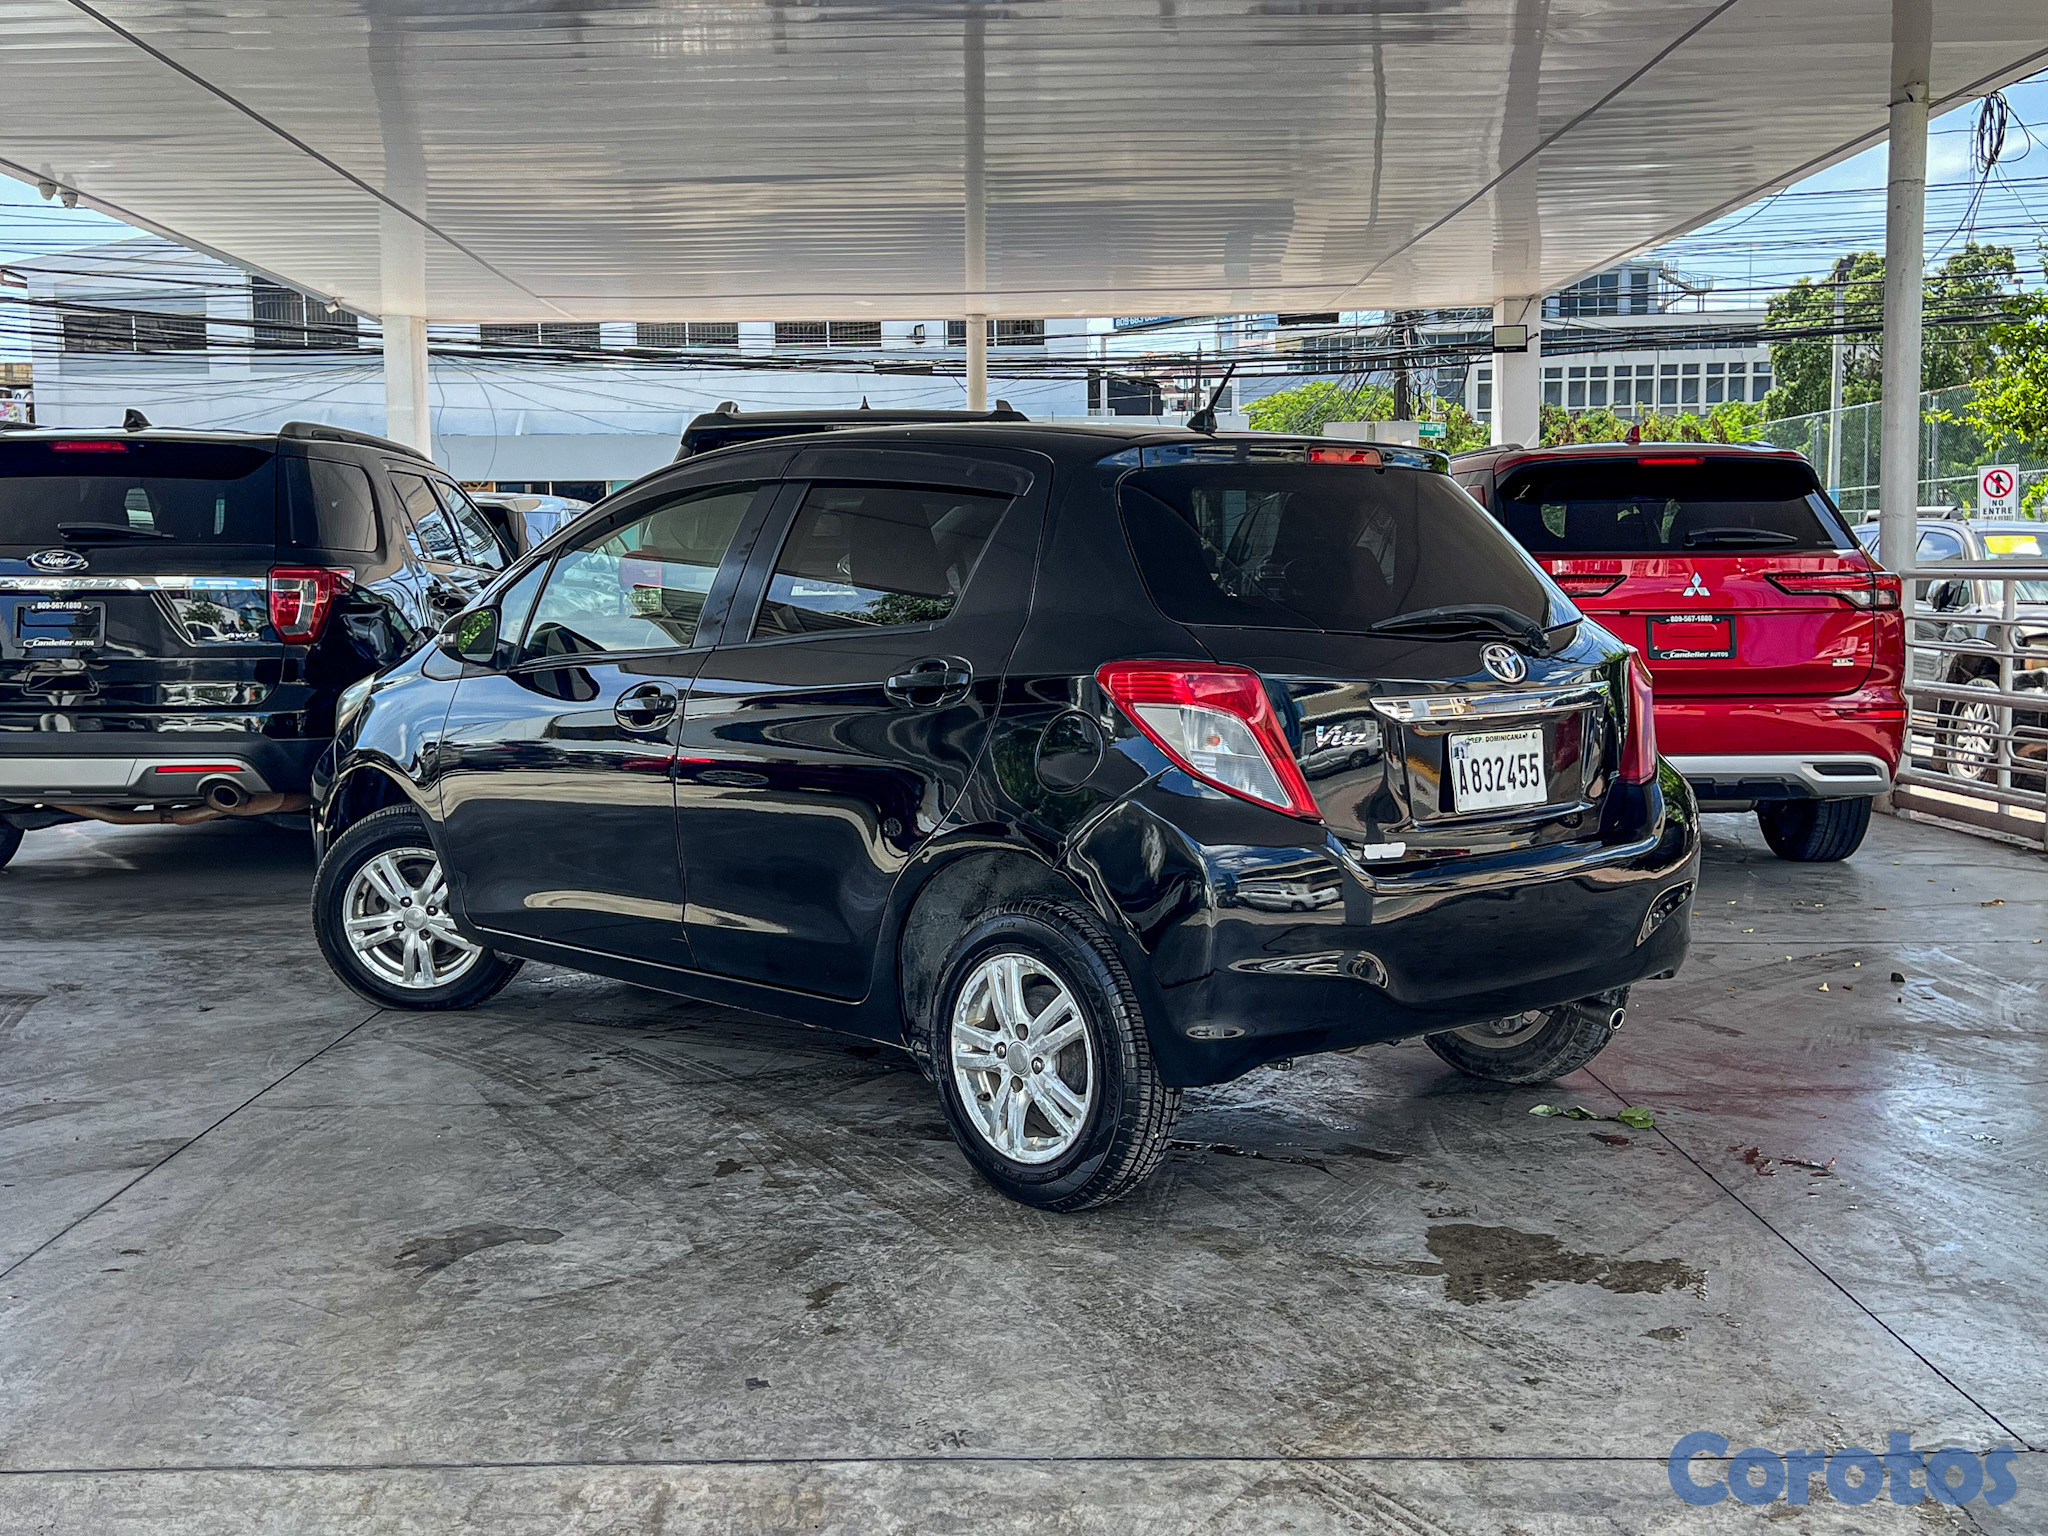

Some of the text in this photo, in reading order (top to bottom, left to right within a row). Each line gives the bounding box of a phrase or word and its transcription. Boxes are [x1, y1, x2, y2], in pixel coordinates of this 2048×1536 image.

[1983, 507, 2013, 515] ENTRE
[42, 552, 72, 565] Ford
[1316, 725, 1367, 748] Vitz
[1485, 734, 1523, 743] DOMINICANA
[1459, 753, 1540, 796] A832455
